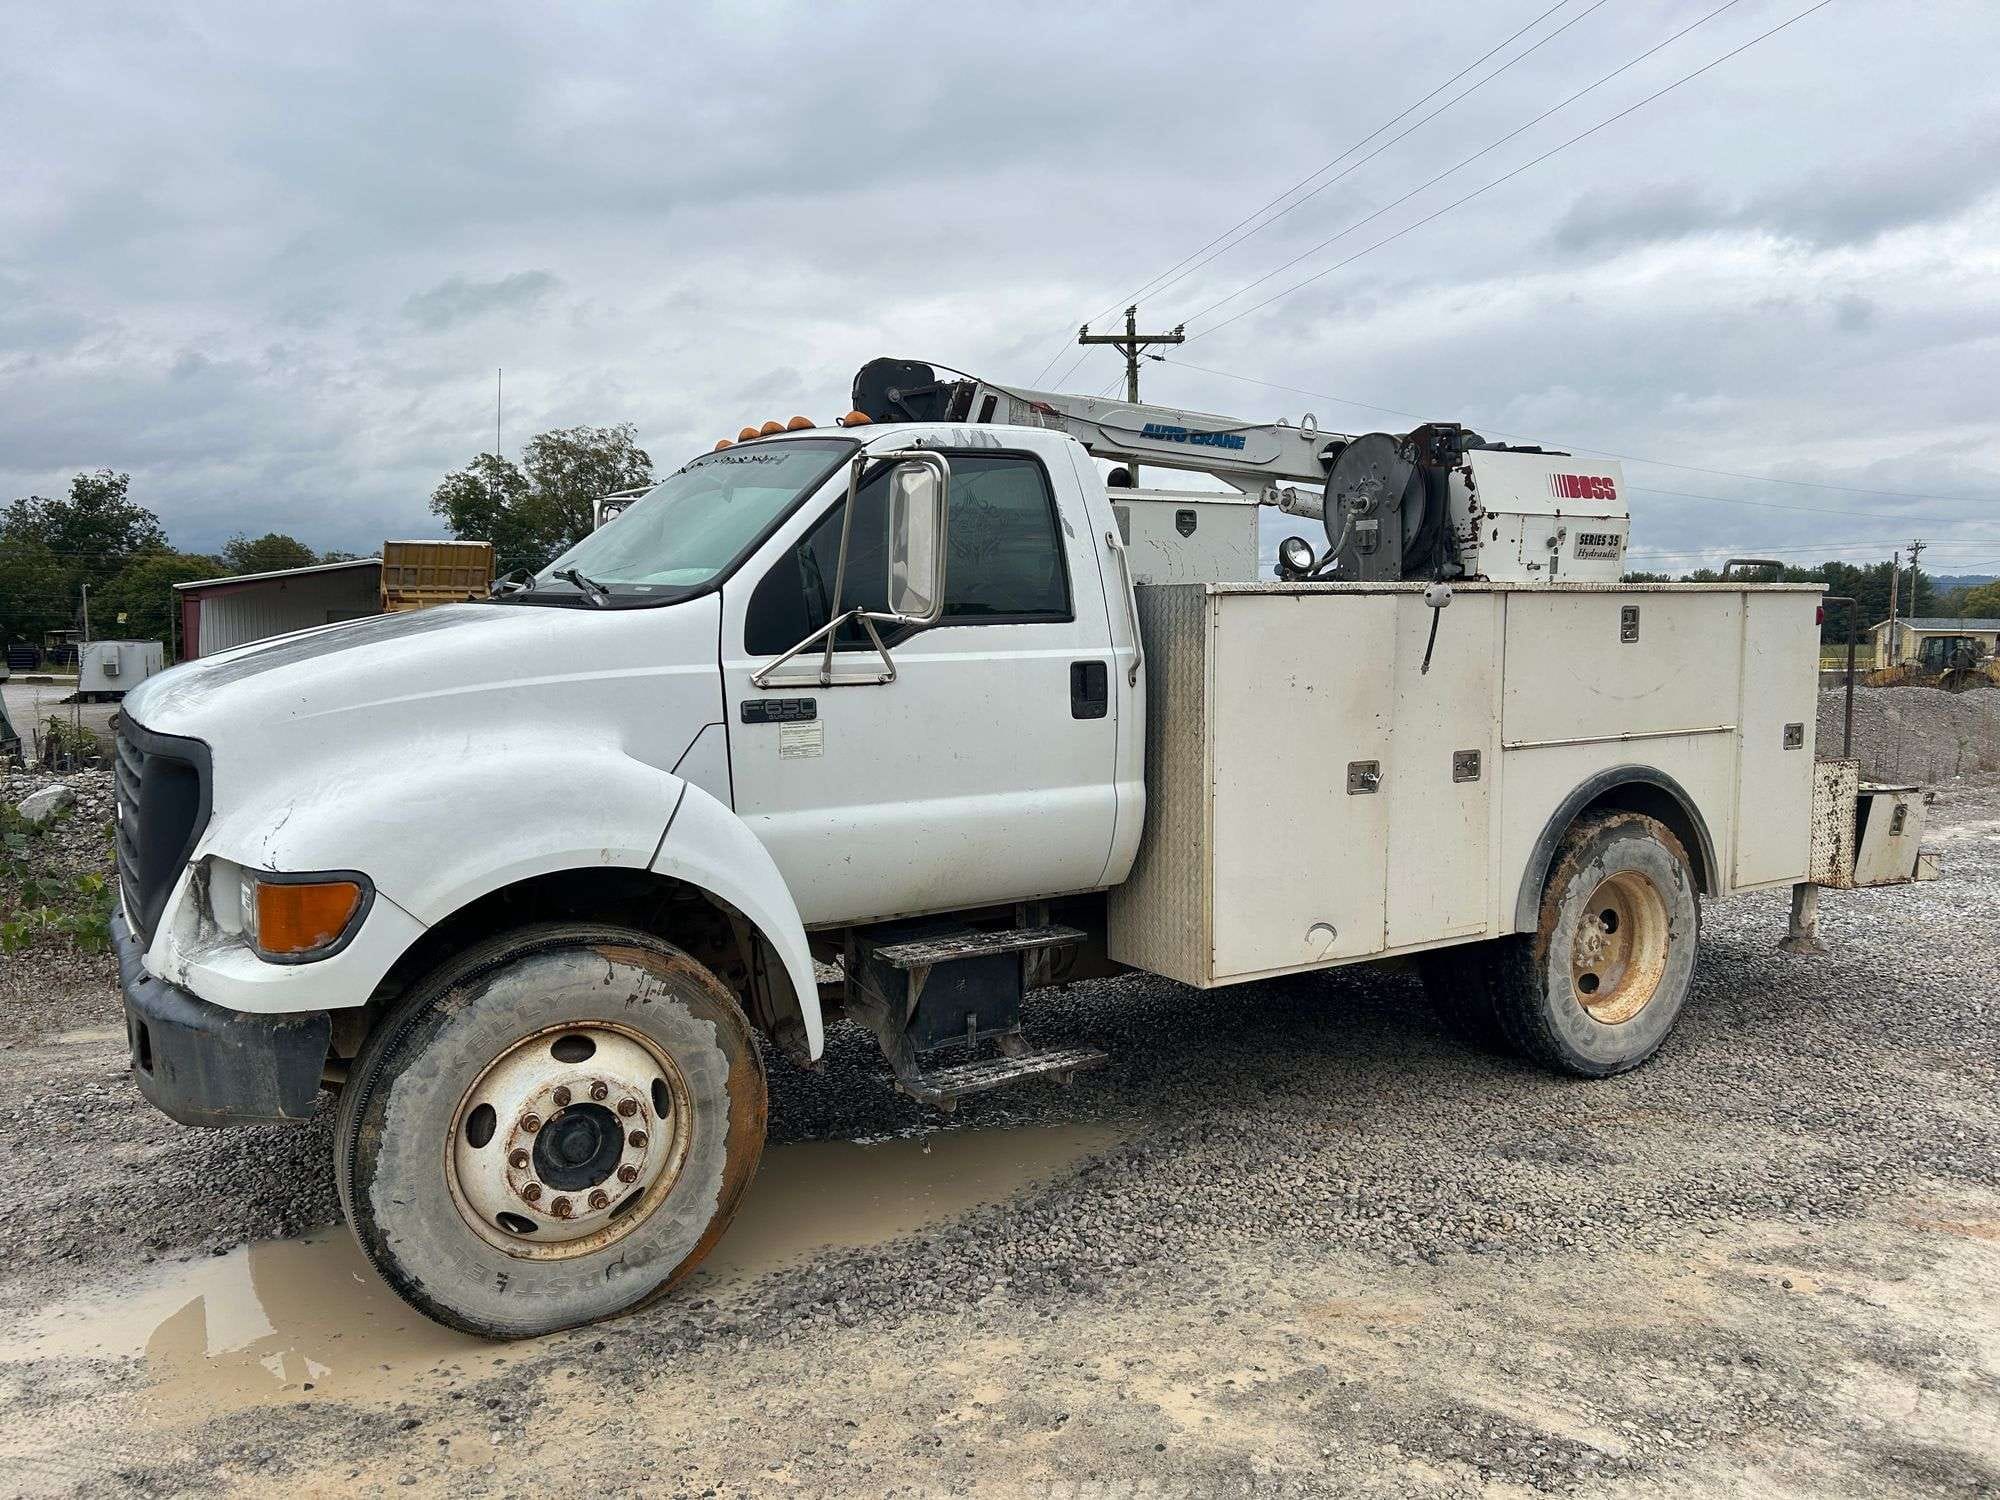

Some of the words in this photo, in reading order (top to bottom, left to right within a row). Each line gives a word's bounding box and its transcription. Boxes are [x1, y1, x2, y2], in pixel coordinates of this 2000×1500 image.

[1139, 423, 1188, 443] AUTO
[1189, 429, 1247, 450] CRANE
[1567, 474, 1617, 500] BOSS
[1579, 533, 1606, 546] SERIES
[1608, 534, 1619, 546] 35
[1577, 548, 1618, 559] Hydraulic
[743, 699, 816, 716] F-650
